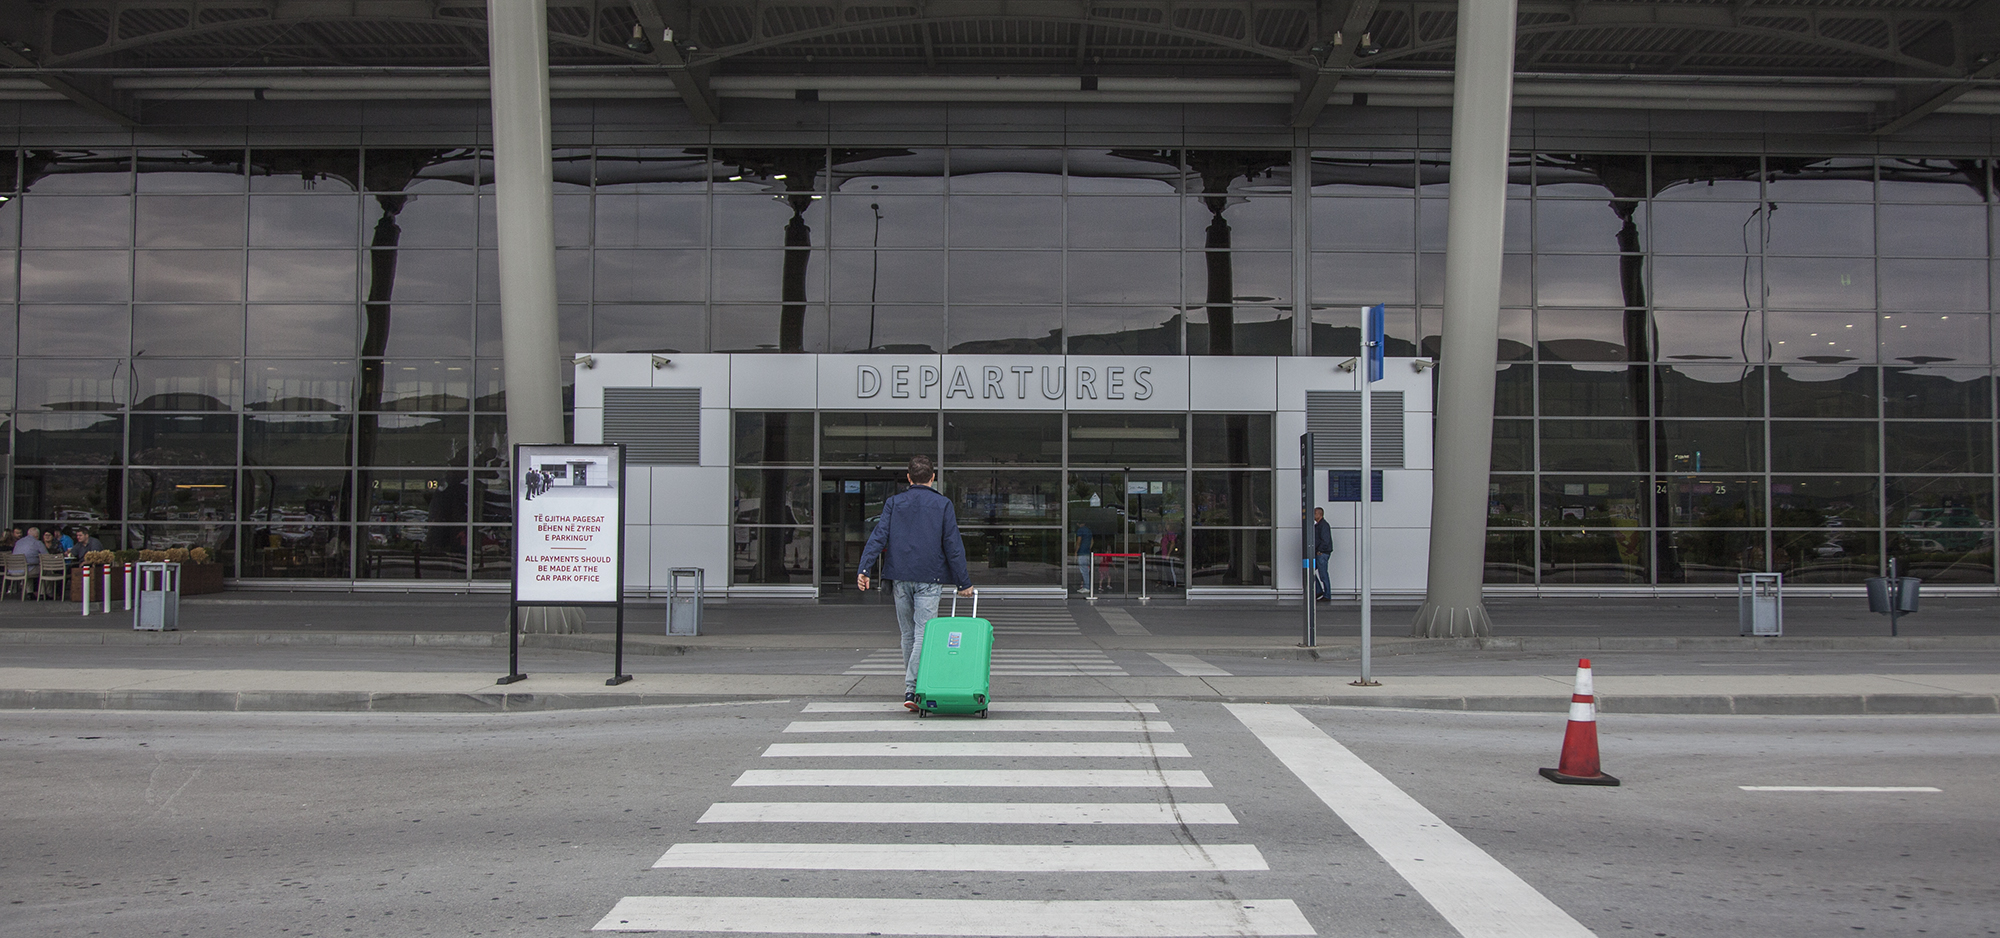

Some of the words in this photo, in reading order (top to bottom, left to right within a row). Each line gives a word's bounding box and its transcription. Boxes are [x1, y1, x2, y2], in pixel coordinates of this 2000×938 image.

[857, 365, 1153, 400] DEPARTURES
[427, 480, 438, 489] 03
[1656, 485, 1667, 494] 24
[1715, 485, 1726, 494] 25
[534, 514, 543, 522] TË
[545, 515, 571, 523] GJITHA
[573, 515, 605, 523] PAGESAT
[537, 523, 563, 532] BËHEN
[565, 524, 575, 532] NË
[536, 574, 551, 582] CAR
